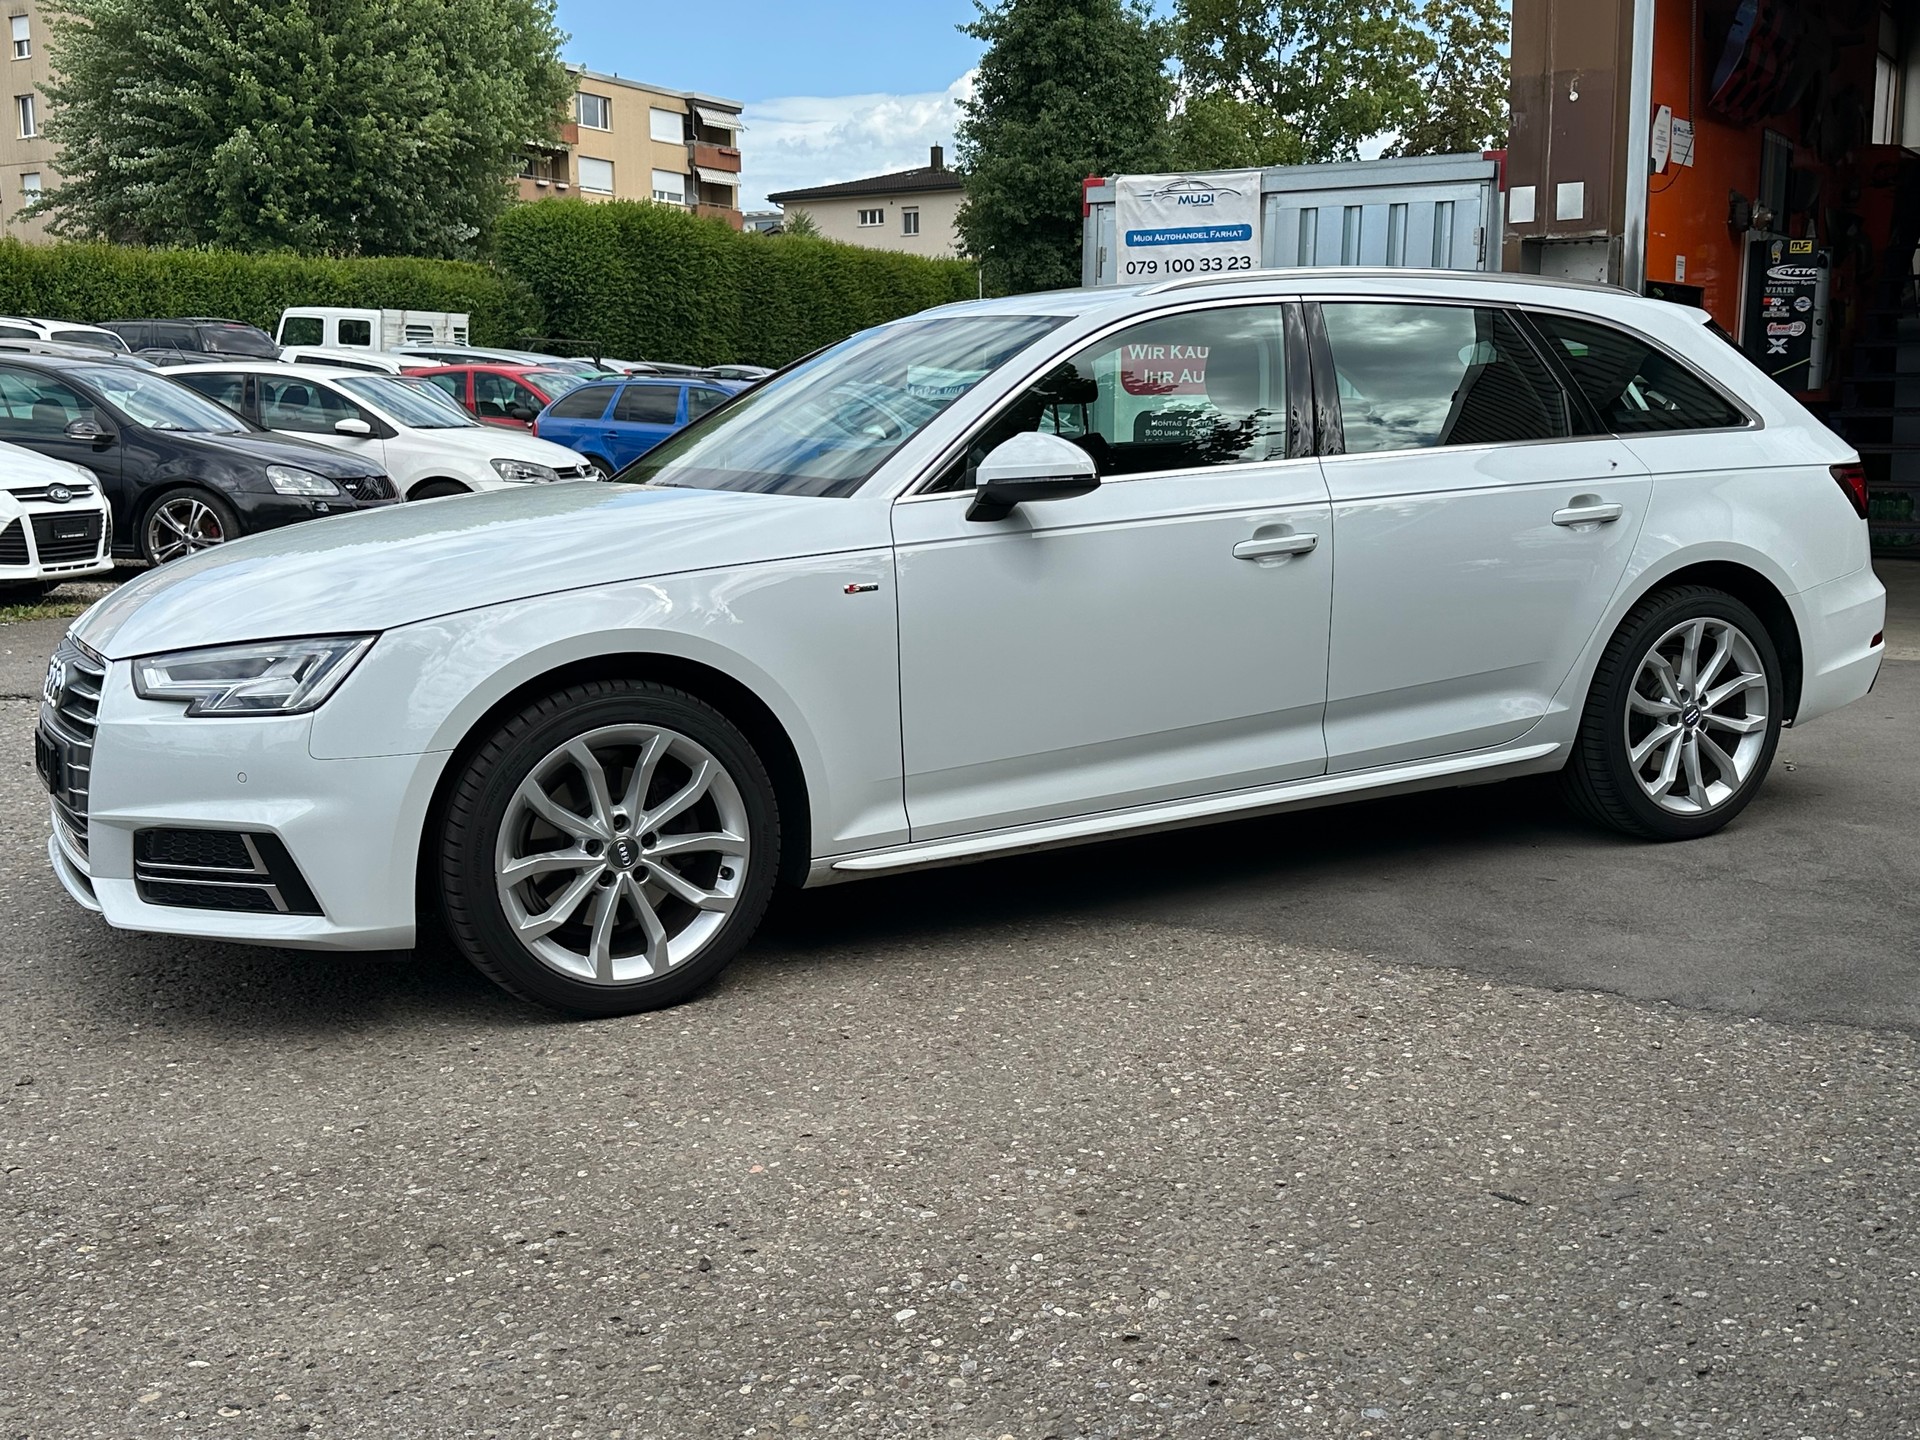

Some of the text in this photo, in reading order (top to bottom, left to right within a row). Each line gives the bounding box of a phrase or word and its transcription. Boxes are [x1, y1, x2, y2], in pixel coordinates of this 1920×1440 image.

[1178, 194, 1214, 205] MUDI
[1133, 230, 1243, 242] MUDI AUTOHANDEL FARHAT
[1126, 256, 1251, 275] 079 100 33 23
[1128, 344, 1209, 360] WIR KAU
[1143, 369, 1205, 384] IHR AU
